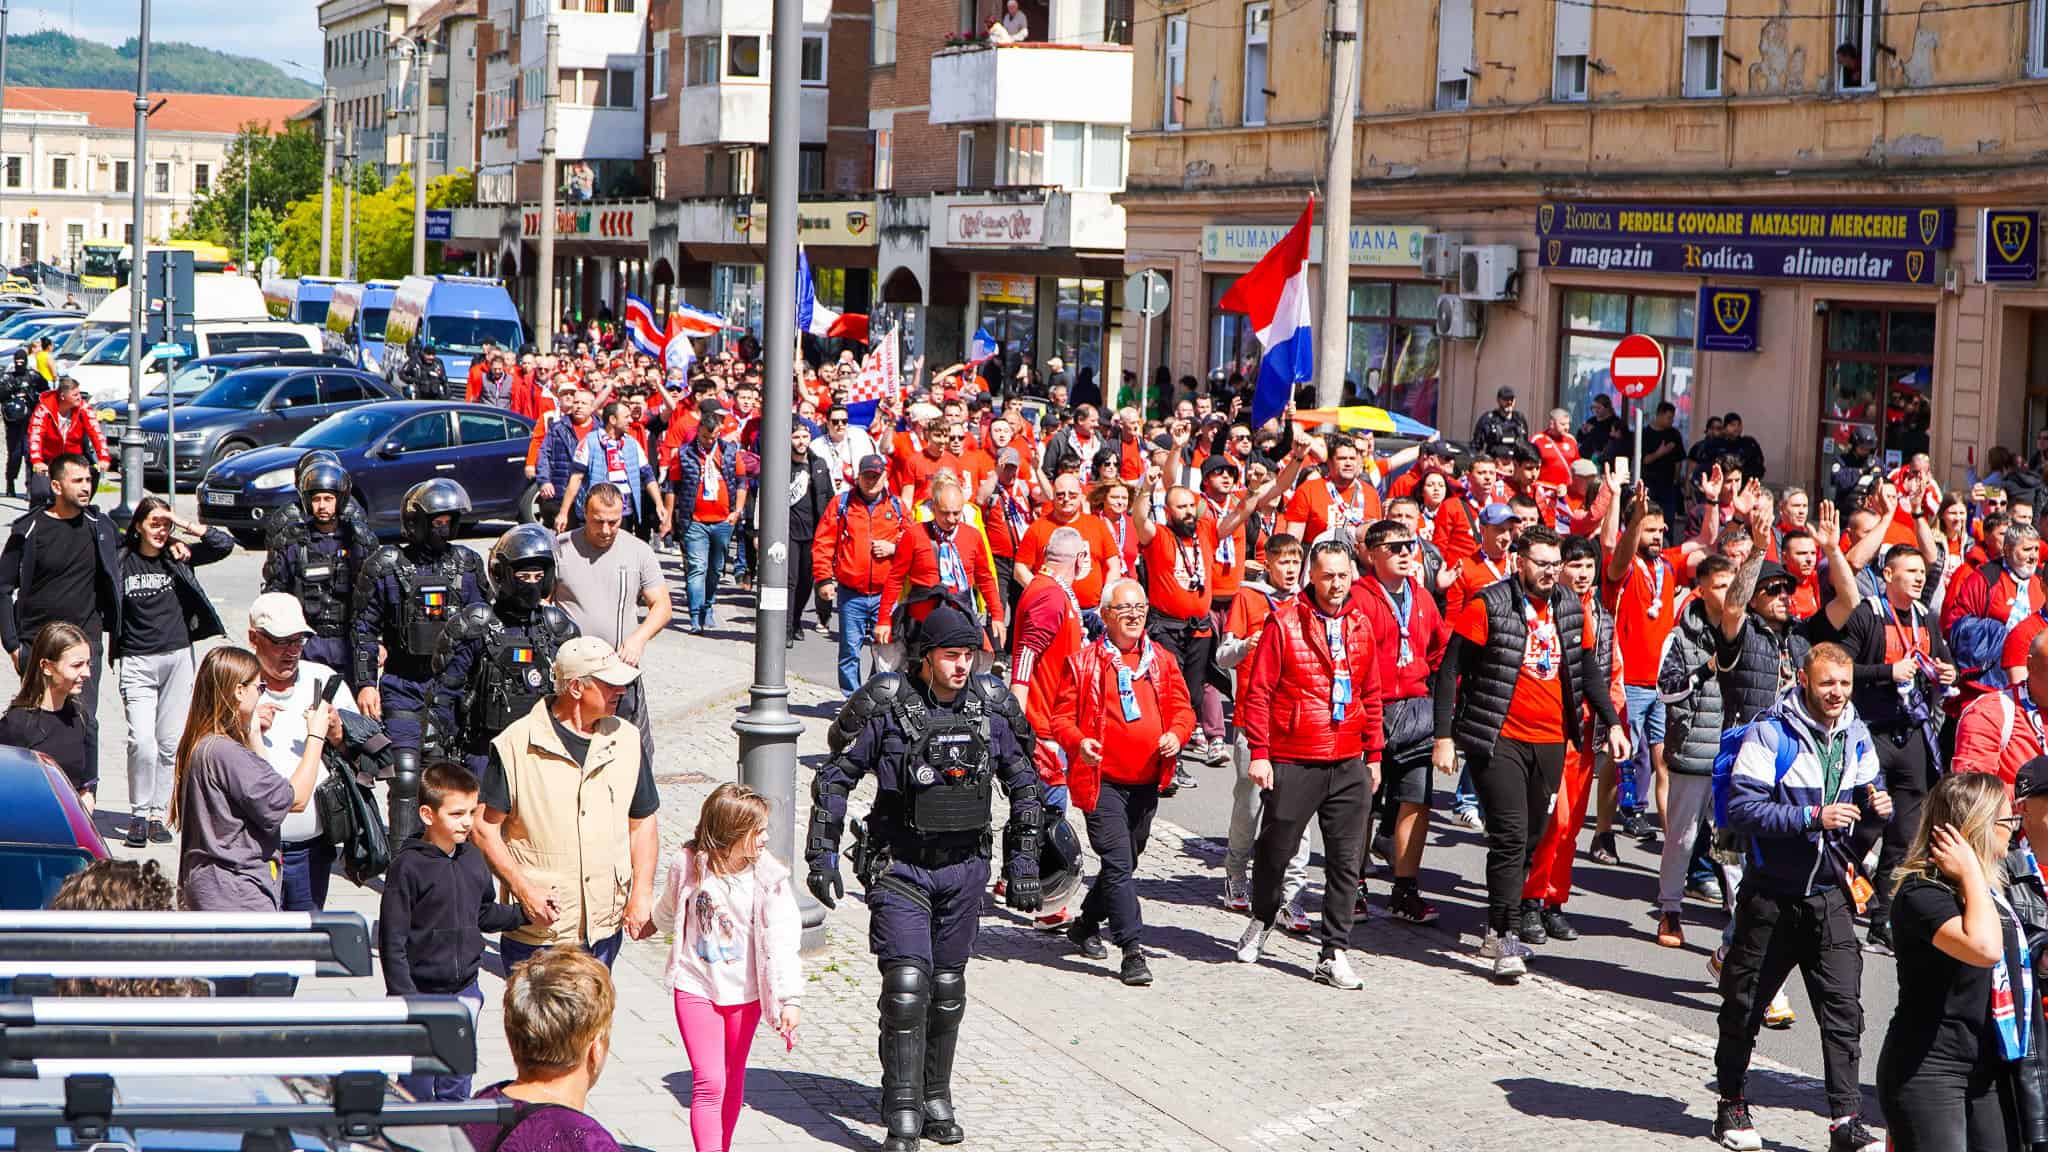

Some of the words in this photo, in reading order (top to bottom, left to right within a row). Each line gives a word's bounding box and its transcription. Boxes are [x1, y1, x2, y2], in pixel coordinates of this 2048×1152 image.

[1225, 228, 1289, 248] HUMAN
[1618, 210, 1674, 233] PERDELE
[1678, 211, 1744, 235] COVOARE
[1750, 213, 1825, 237] MATASURI
[1829, 215, 1908, 239] MERCERIE
[1570, 242, 1653, 270] magazin
[1682, 243, 1754, 270] Rodica
[1783, 248, 1892, 278] alimentar
